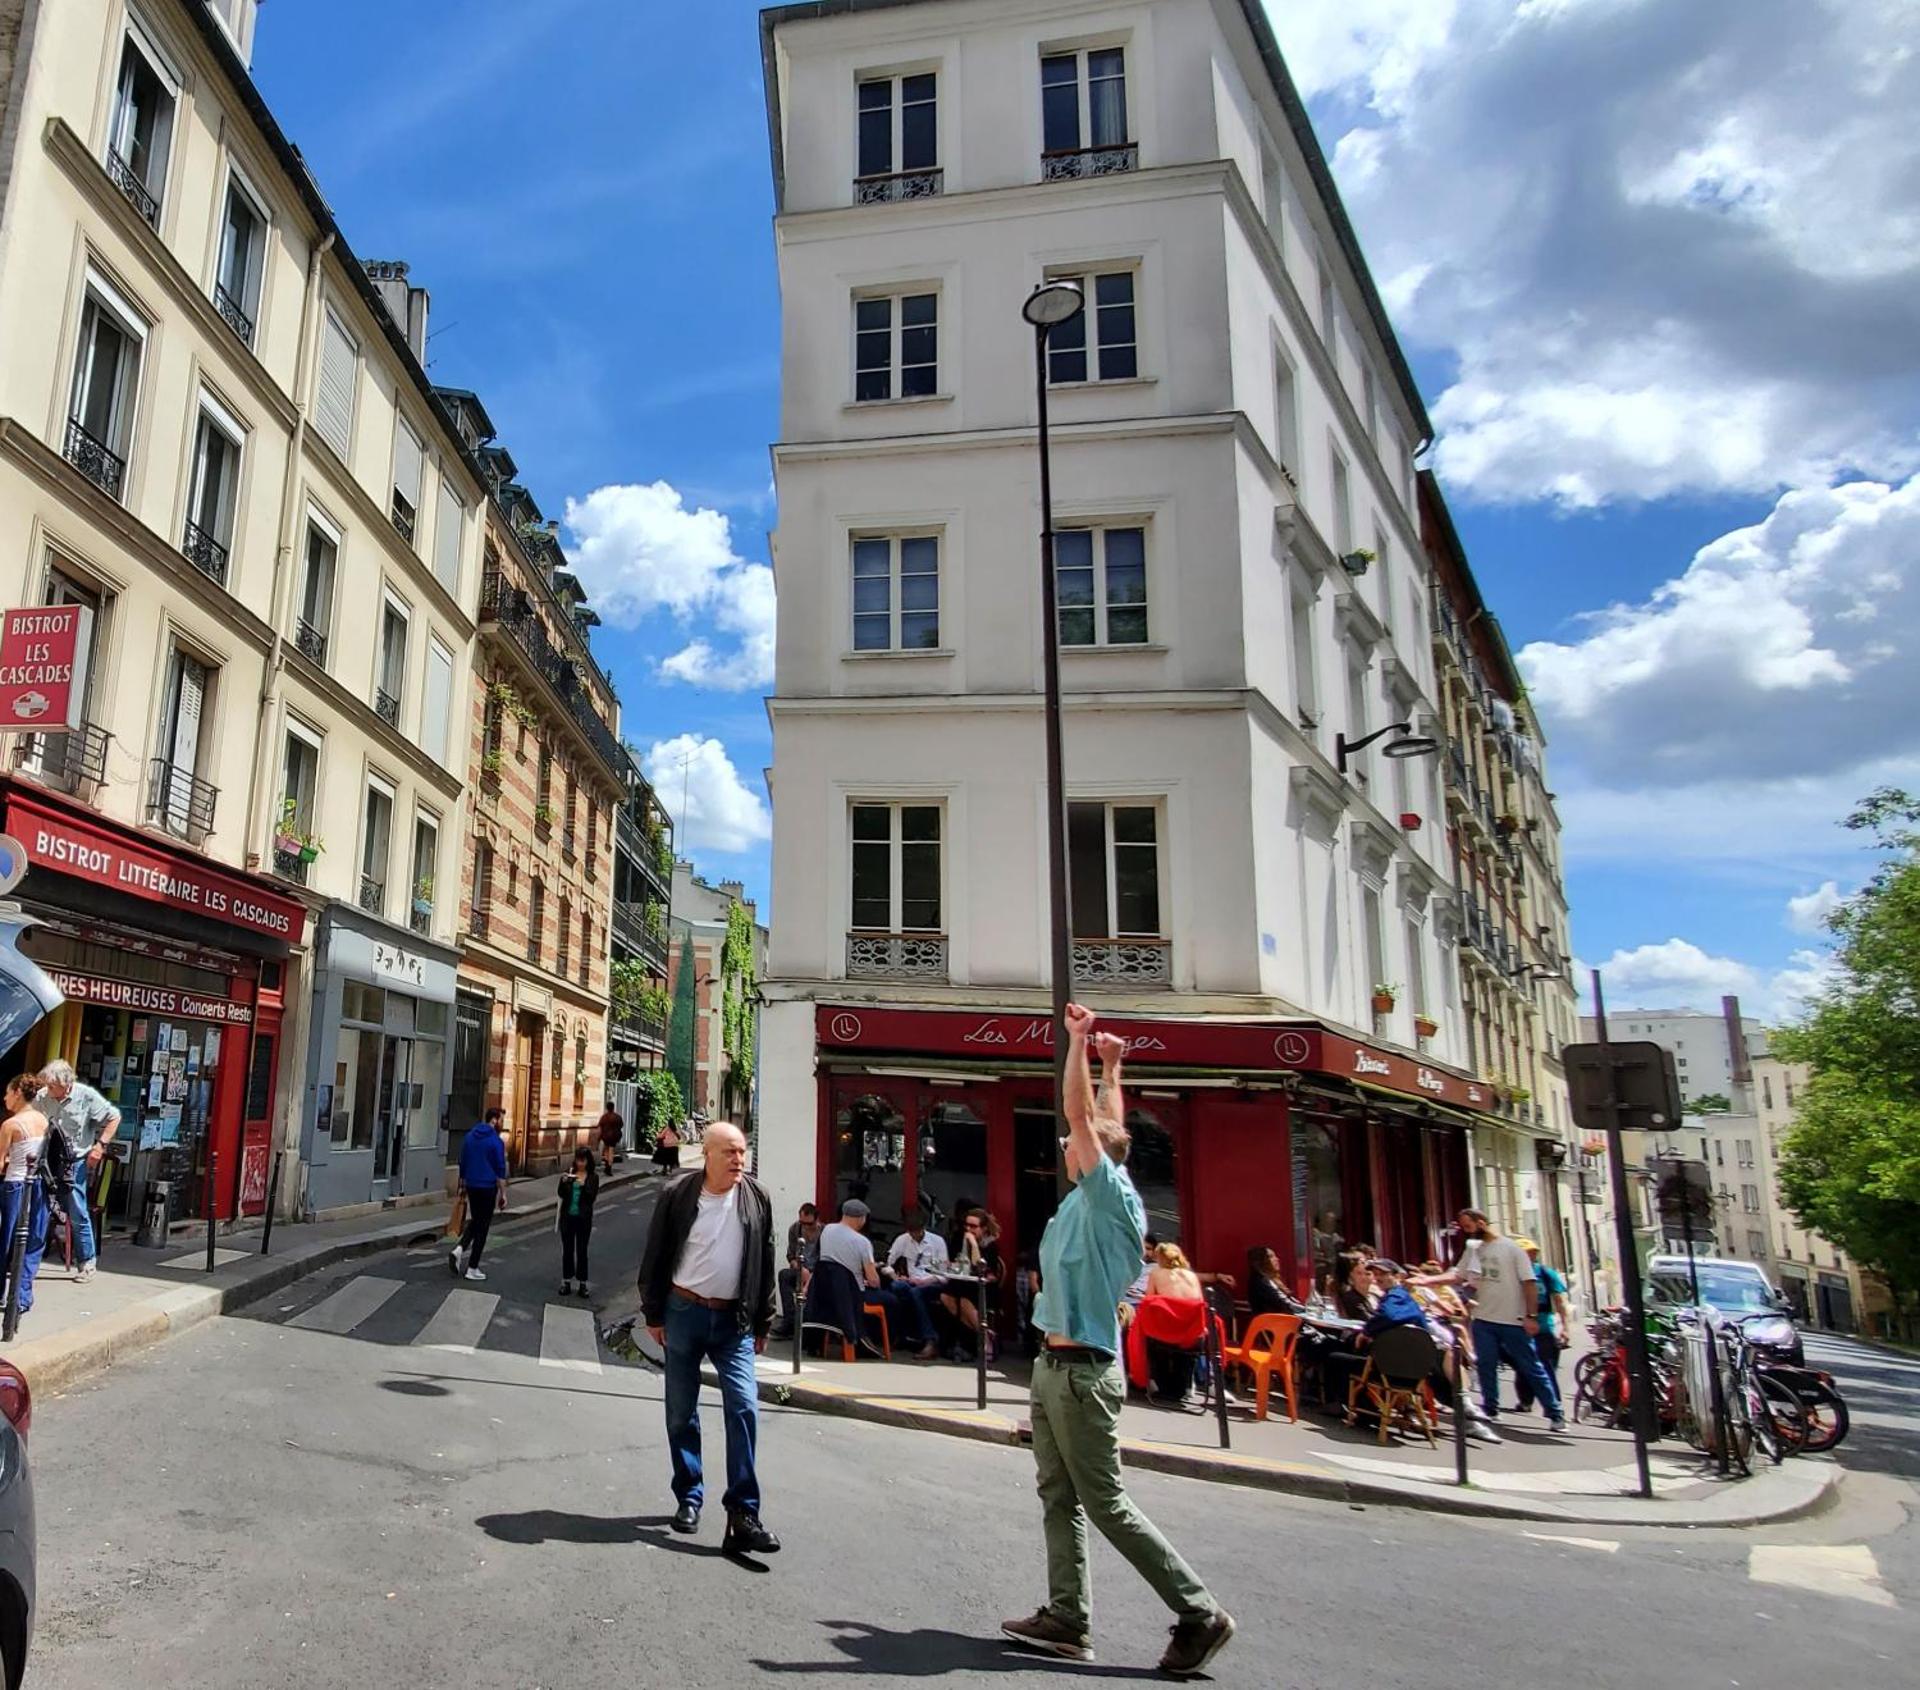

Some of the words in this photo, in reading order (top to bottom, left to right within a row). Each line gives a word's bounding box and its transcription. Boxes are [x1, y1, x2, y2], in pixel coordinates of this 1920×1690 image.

[12, 615, 72, 635] BISTROT
[25, 643, 50, 662] LES
[0, 664, 71, 685] CASCADES
[36, 831, 112, 874] BISTROT
[119, 859, 200, 904] LITTÉRAIRE
[205, 889, 227, 912] LES
[233, 899, 290, 933] CASCADES
[90, 980, 176, 1011] HEUREUSES
[181, 996, 226, 1020] Concerts
[227, 1003, 252, 1022] Resto
[963, 1018, 1008, 1044] Les
